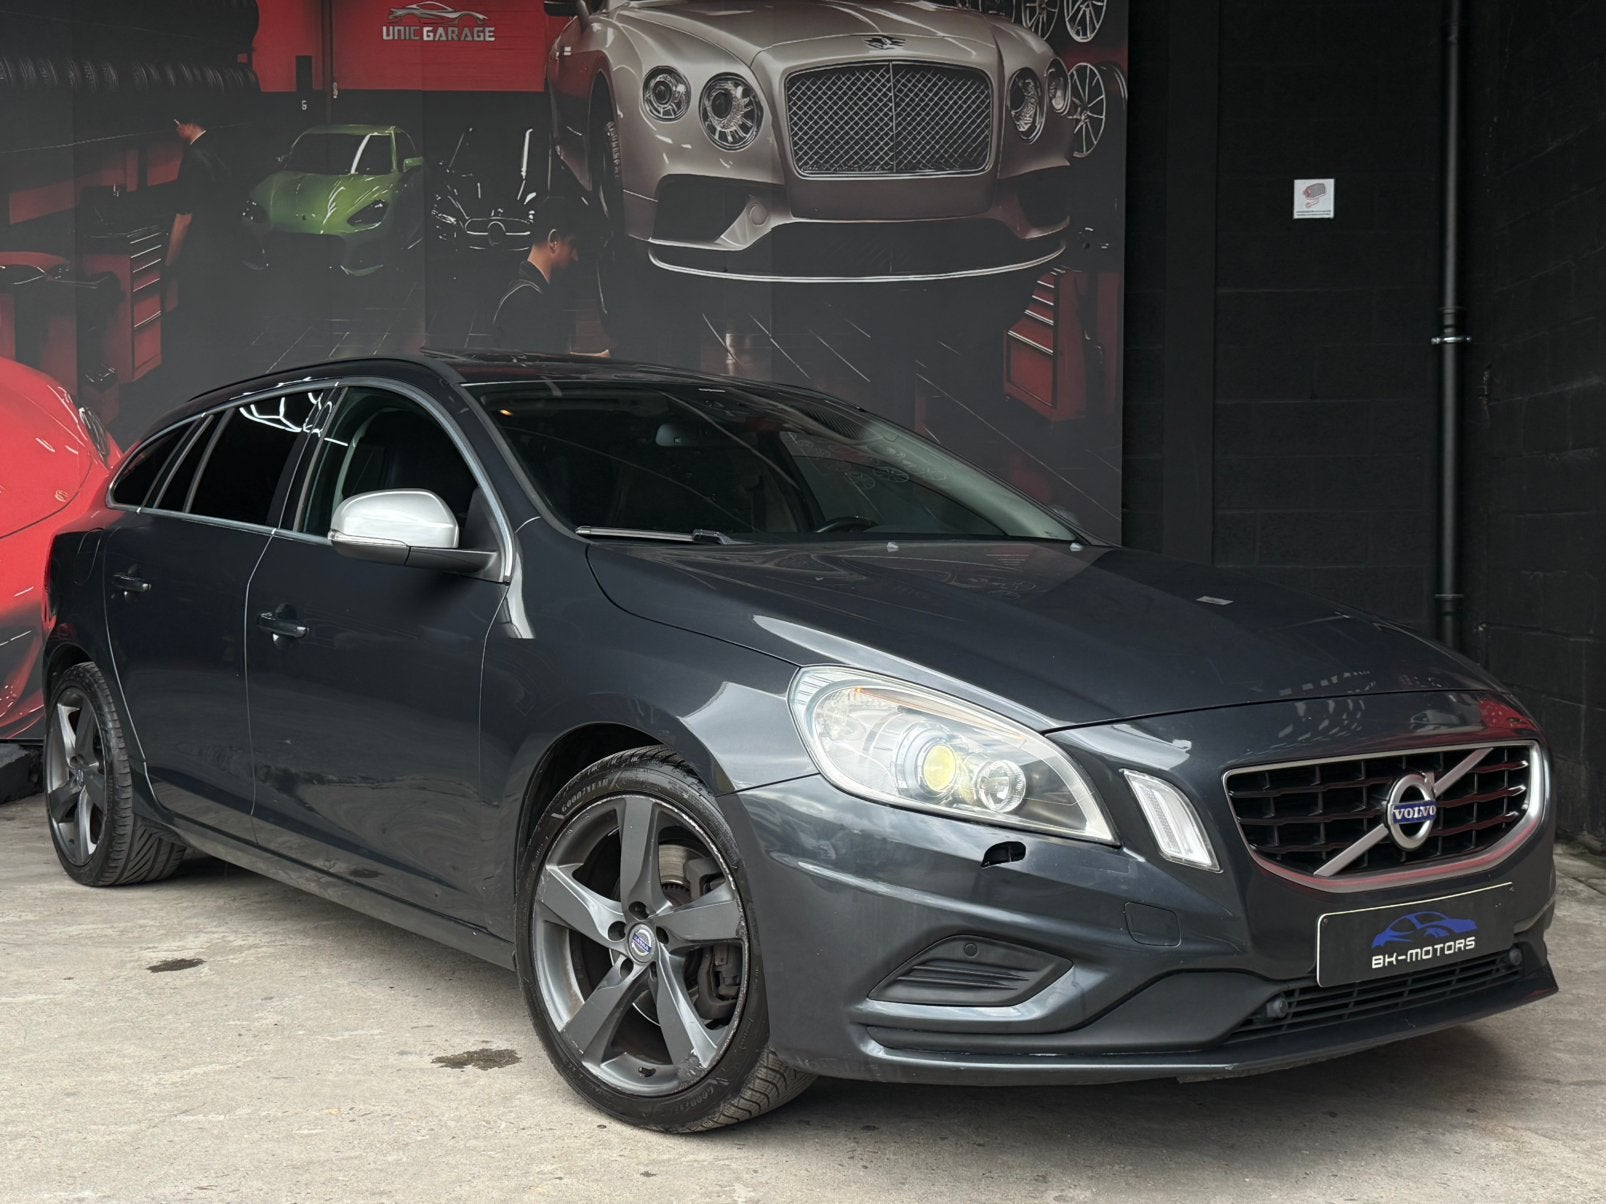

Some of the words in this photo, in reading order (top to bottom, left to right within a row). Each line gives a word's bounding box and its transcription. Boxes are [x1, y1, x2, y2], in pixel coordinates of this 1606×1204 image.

[382, 26, 420, 40] UNIC
[422, 26, 496, 41] GARAGE
[1393, 805, 1437, 820] VOLVO
[1371, 936, 1476, 969] BK-MOTORS
